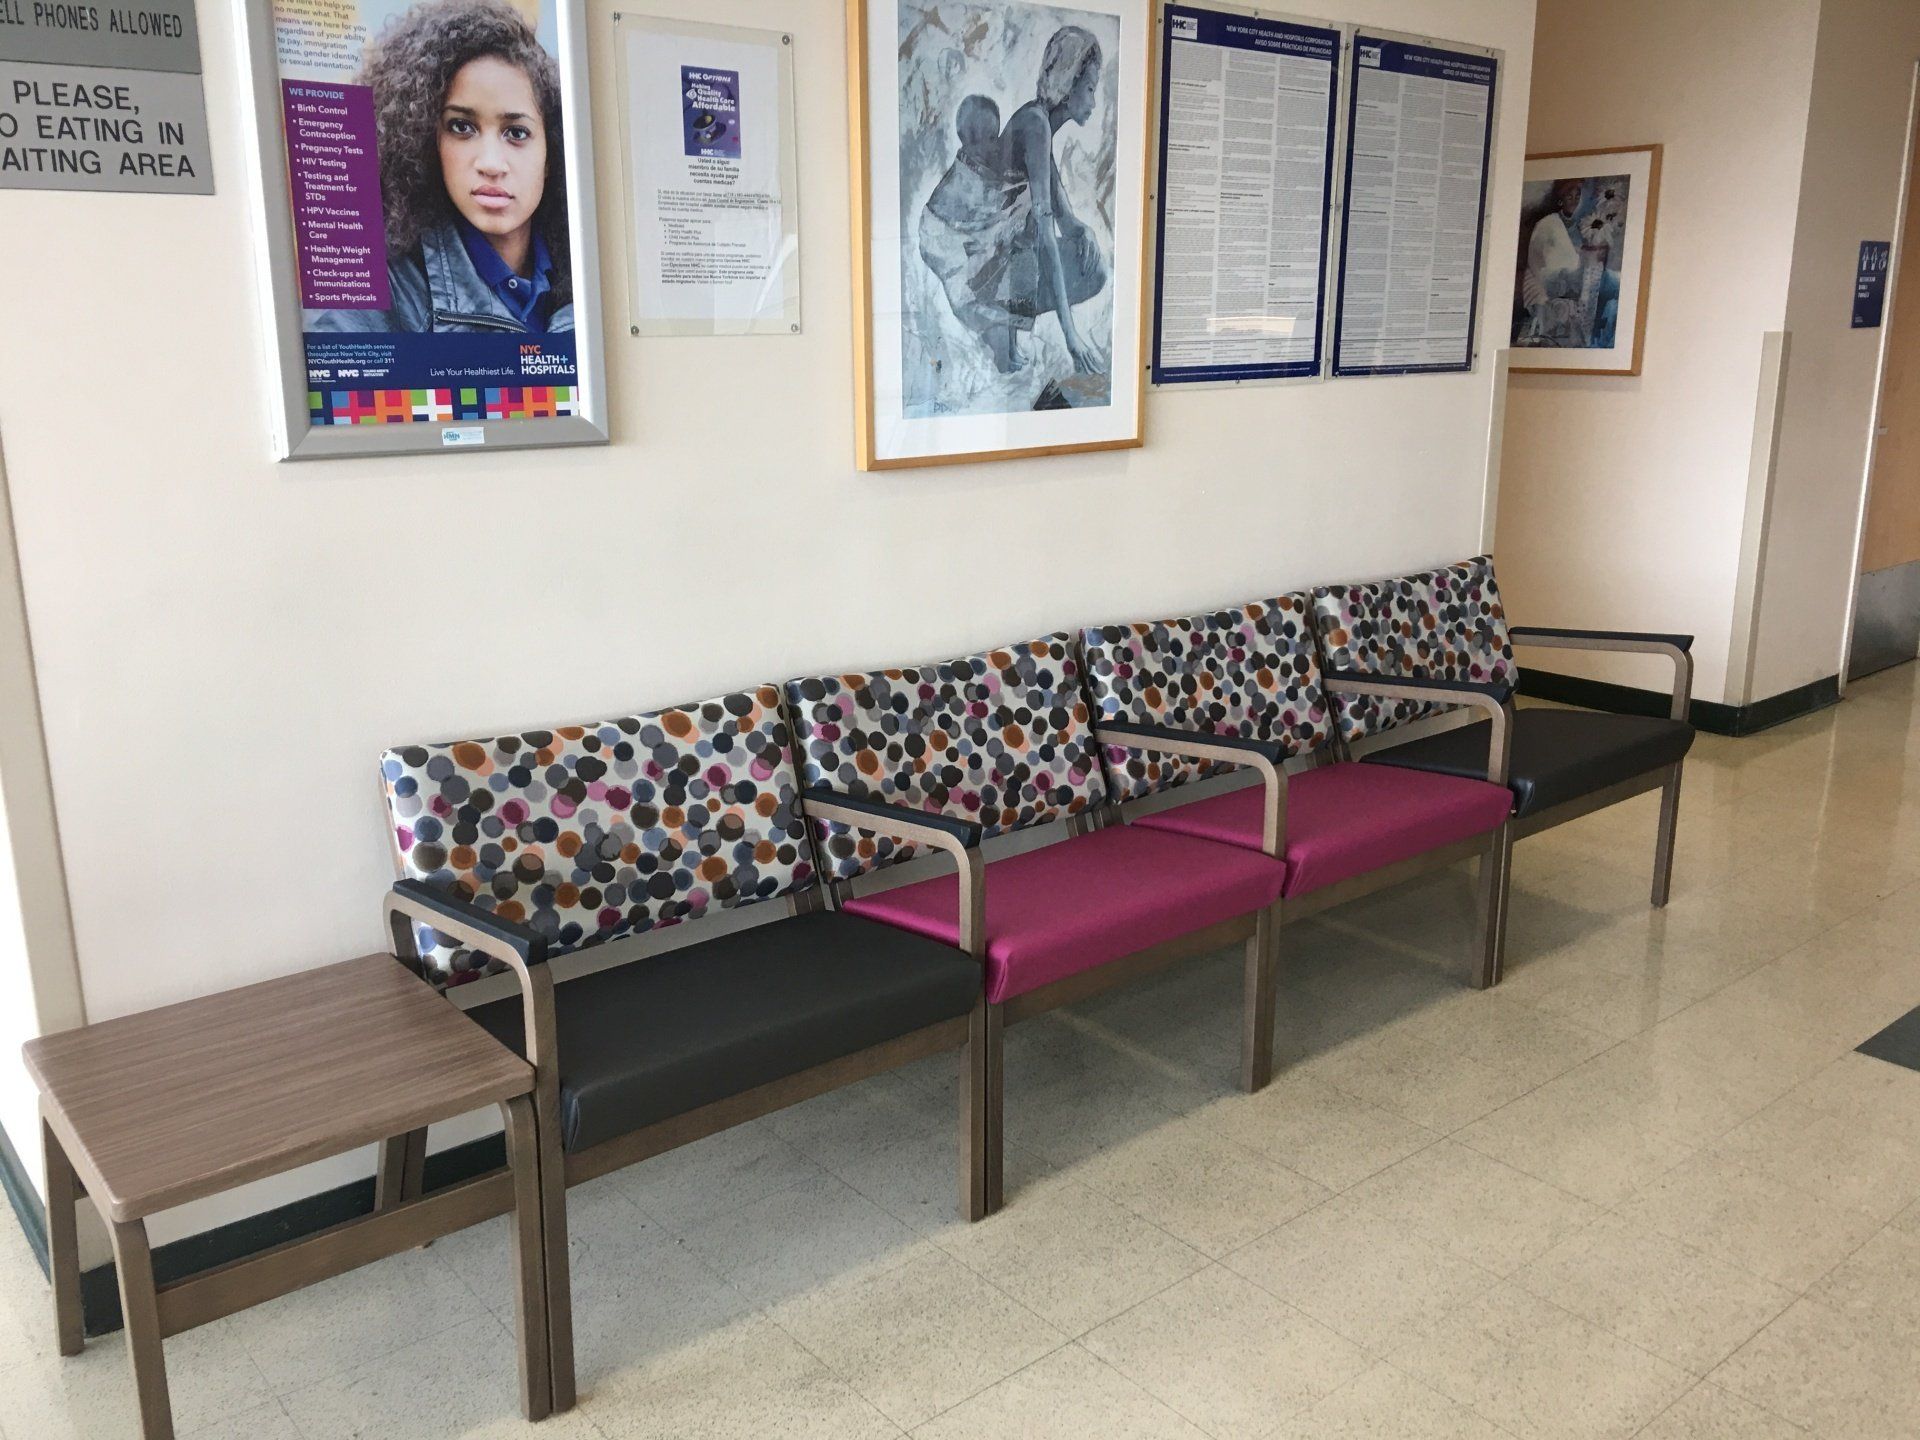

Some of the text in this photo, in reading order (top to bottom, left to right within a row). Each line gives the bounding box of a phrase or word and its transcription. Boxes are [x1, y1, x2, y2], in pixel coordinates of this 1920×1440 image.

[34, 2, 99, 31] PHONES
[110, 9, 182, 37] ALLOWED
[334, 10, 348, 19] That
[342, 22, 352, 30] for
[1172, 19, 1186, 29] HHC
[277, 27, 315, 36] regardless
[344, 33, 366, 43] ability
[1237, 26, 1248, 34] YORK
[1284, 33, 1305, 42] HOSPITALS
[1304, 36, 1333, 46] CORPORATION
[304, 40, 348, 49] immigration
[1267, 40, 1281, 48] SOBRE
[1308, 46, 1332, 55] PRIVACIDAD
[279, 47, 302, 55] status,
[13, 80, 139, 114] PLEASE,
[289, 87, 345, 99] WE PROVIDE
[697, 89, 721, 97] Quality
[297, 104, 348, 115] Birth Control
[692, 101, 736, 112] Affordable
[299, 118, 343, 130] Emergency
[37, 115, 143, 144] EATING
[158, 122, 184, 145] IN
[300, 129, 356, 140] Contraception
[301, 143, 363, 155] Pregnancy Tests
[119, 152, 195, 177] AREA
[318, 158, 346, 169] Testing
[303, 171, 332, 182] Testing
[304, 182, 358, 192] Treatment for
[306, 193, 326, 201] STDs
[307, 206, 360, 216] HPV Vaccines
[308, 221, 363, 230] Mental Health
[309, 231, 328, 239] Care
[310, 245, 371, 256] Healthy Weight
[311, 255, 364, 265] Management
[312, 269, 370, 279] Check-ups and
[313, 280, 371, 288] Immunizations
[315, 293, 377, 302] Sports Physicals
[519, 345, 541, 355] NYC
[308, 369, 331, 378] NYC
[337, 369, 360, 378] NYC
[430, 367, 516, 377] Live Your Healthiest Life.
[521, 364, 576, 375] HOSPITALS
